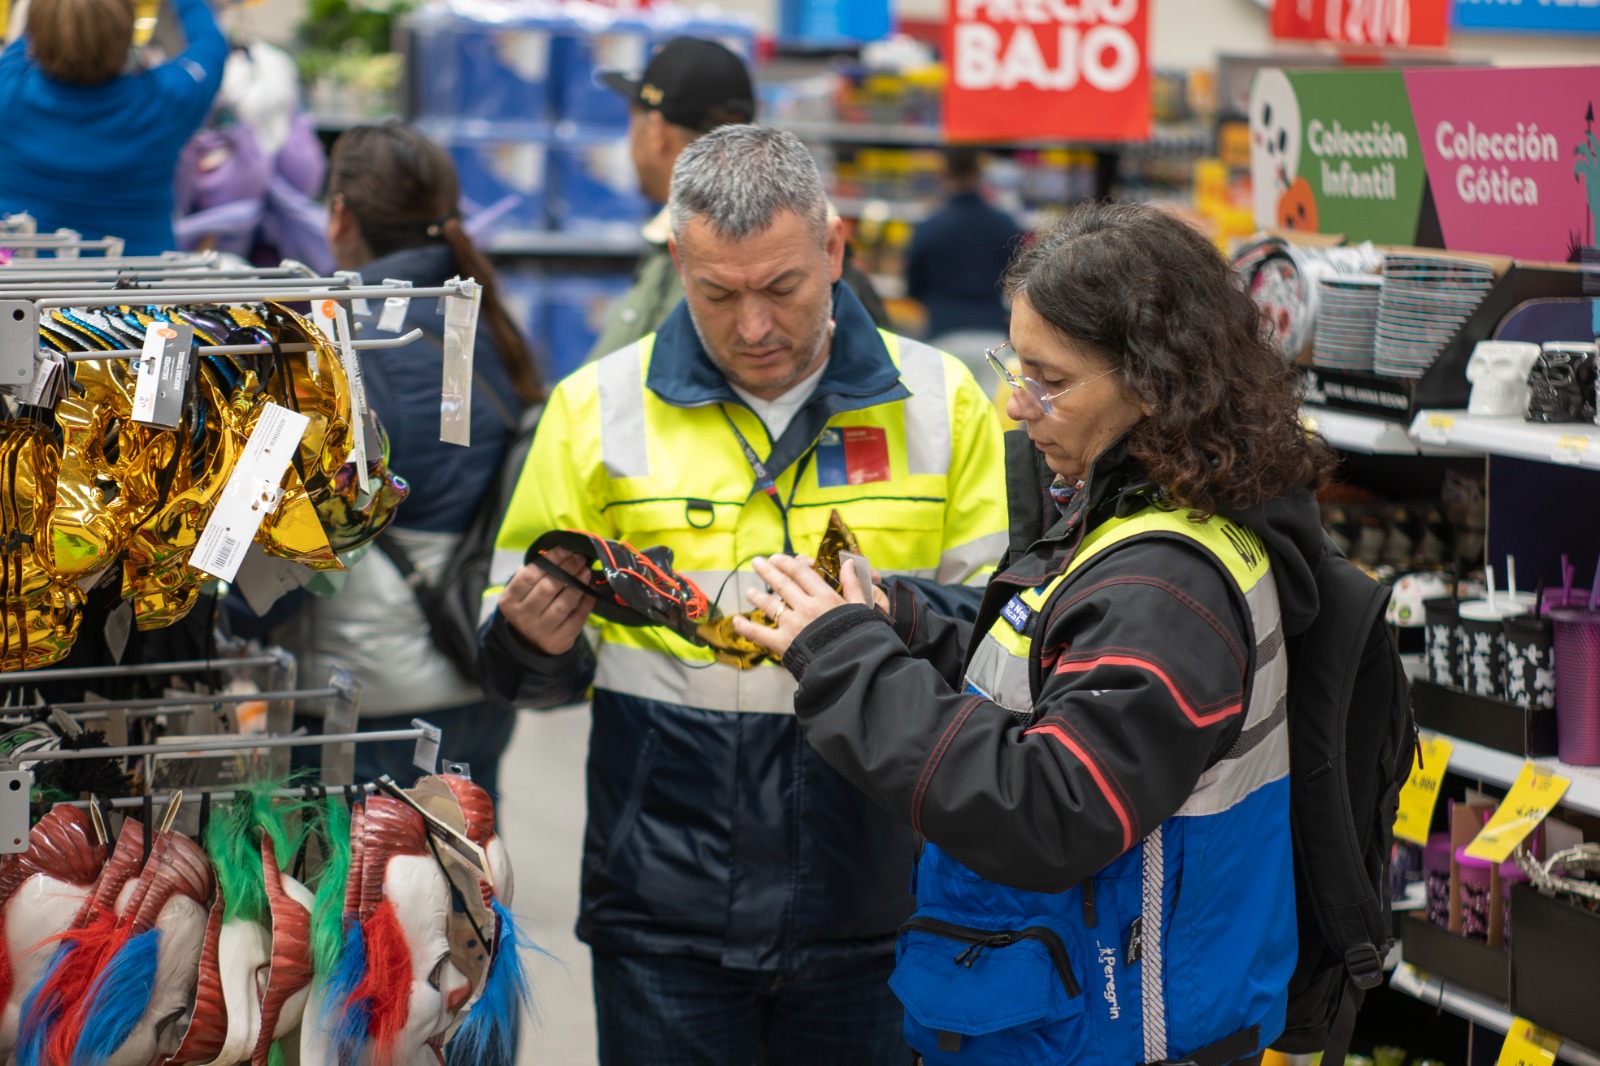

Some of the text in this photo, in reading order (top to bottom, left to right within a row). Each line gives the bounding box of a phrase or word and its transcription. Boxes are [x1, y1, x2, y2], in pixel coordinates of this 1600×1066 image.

[953, 22, 1141, 92] BAJO
[1307, 119, 1408, 159] Colección
[1435, 120, 1558, 161] Colección
[1321, 160, 1397, 200] Infantil
[1456, 163, 1539, 205] Gótica
[1103, 956, 1121, 1019] Peregrin
